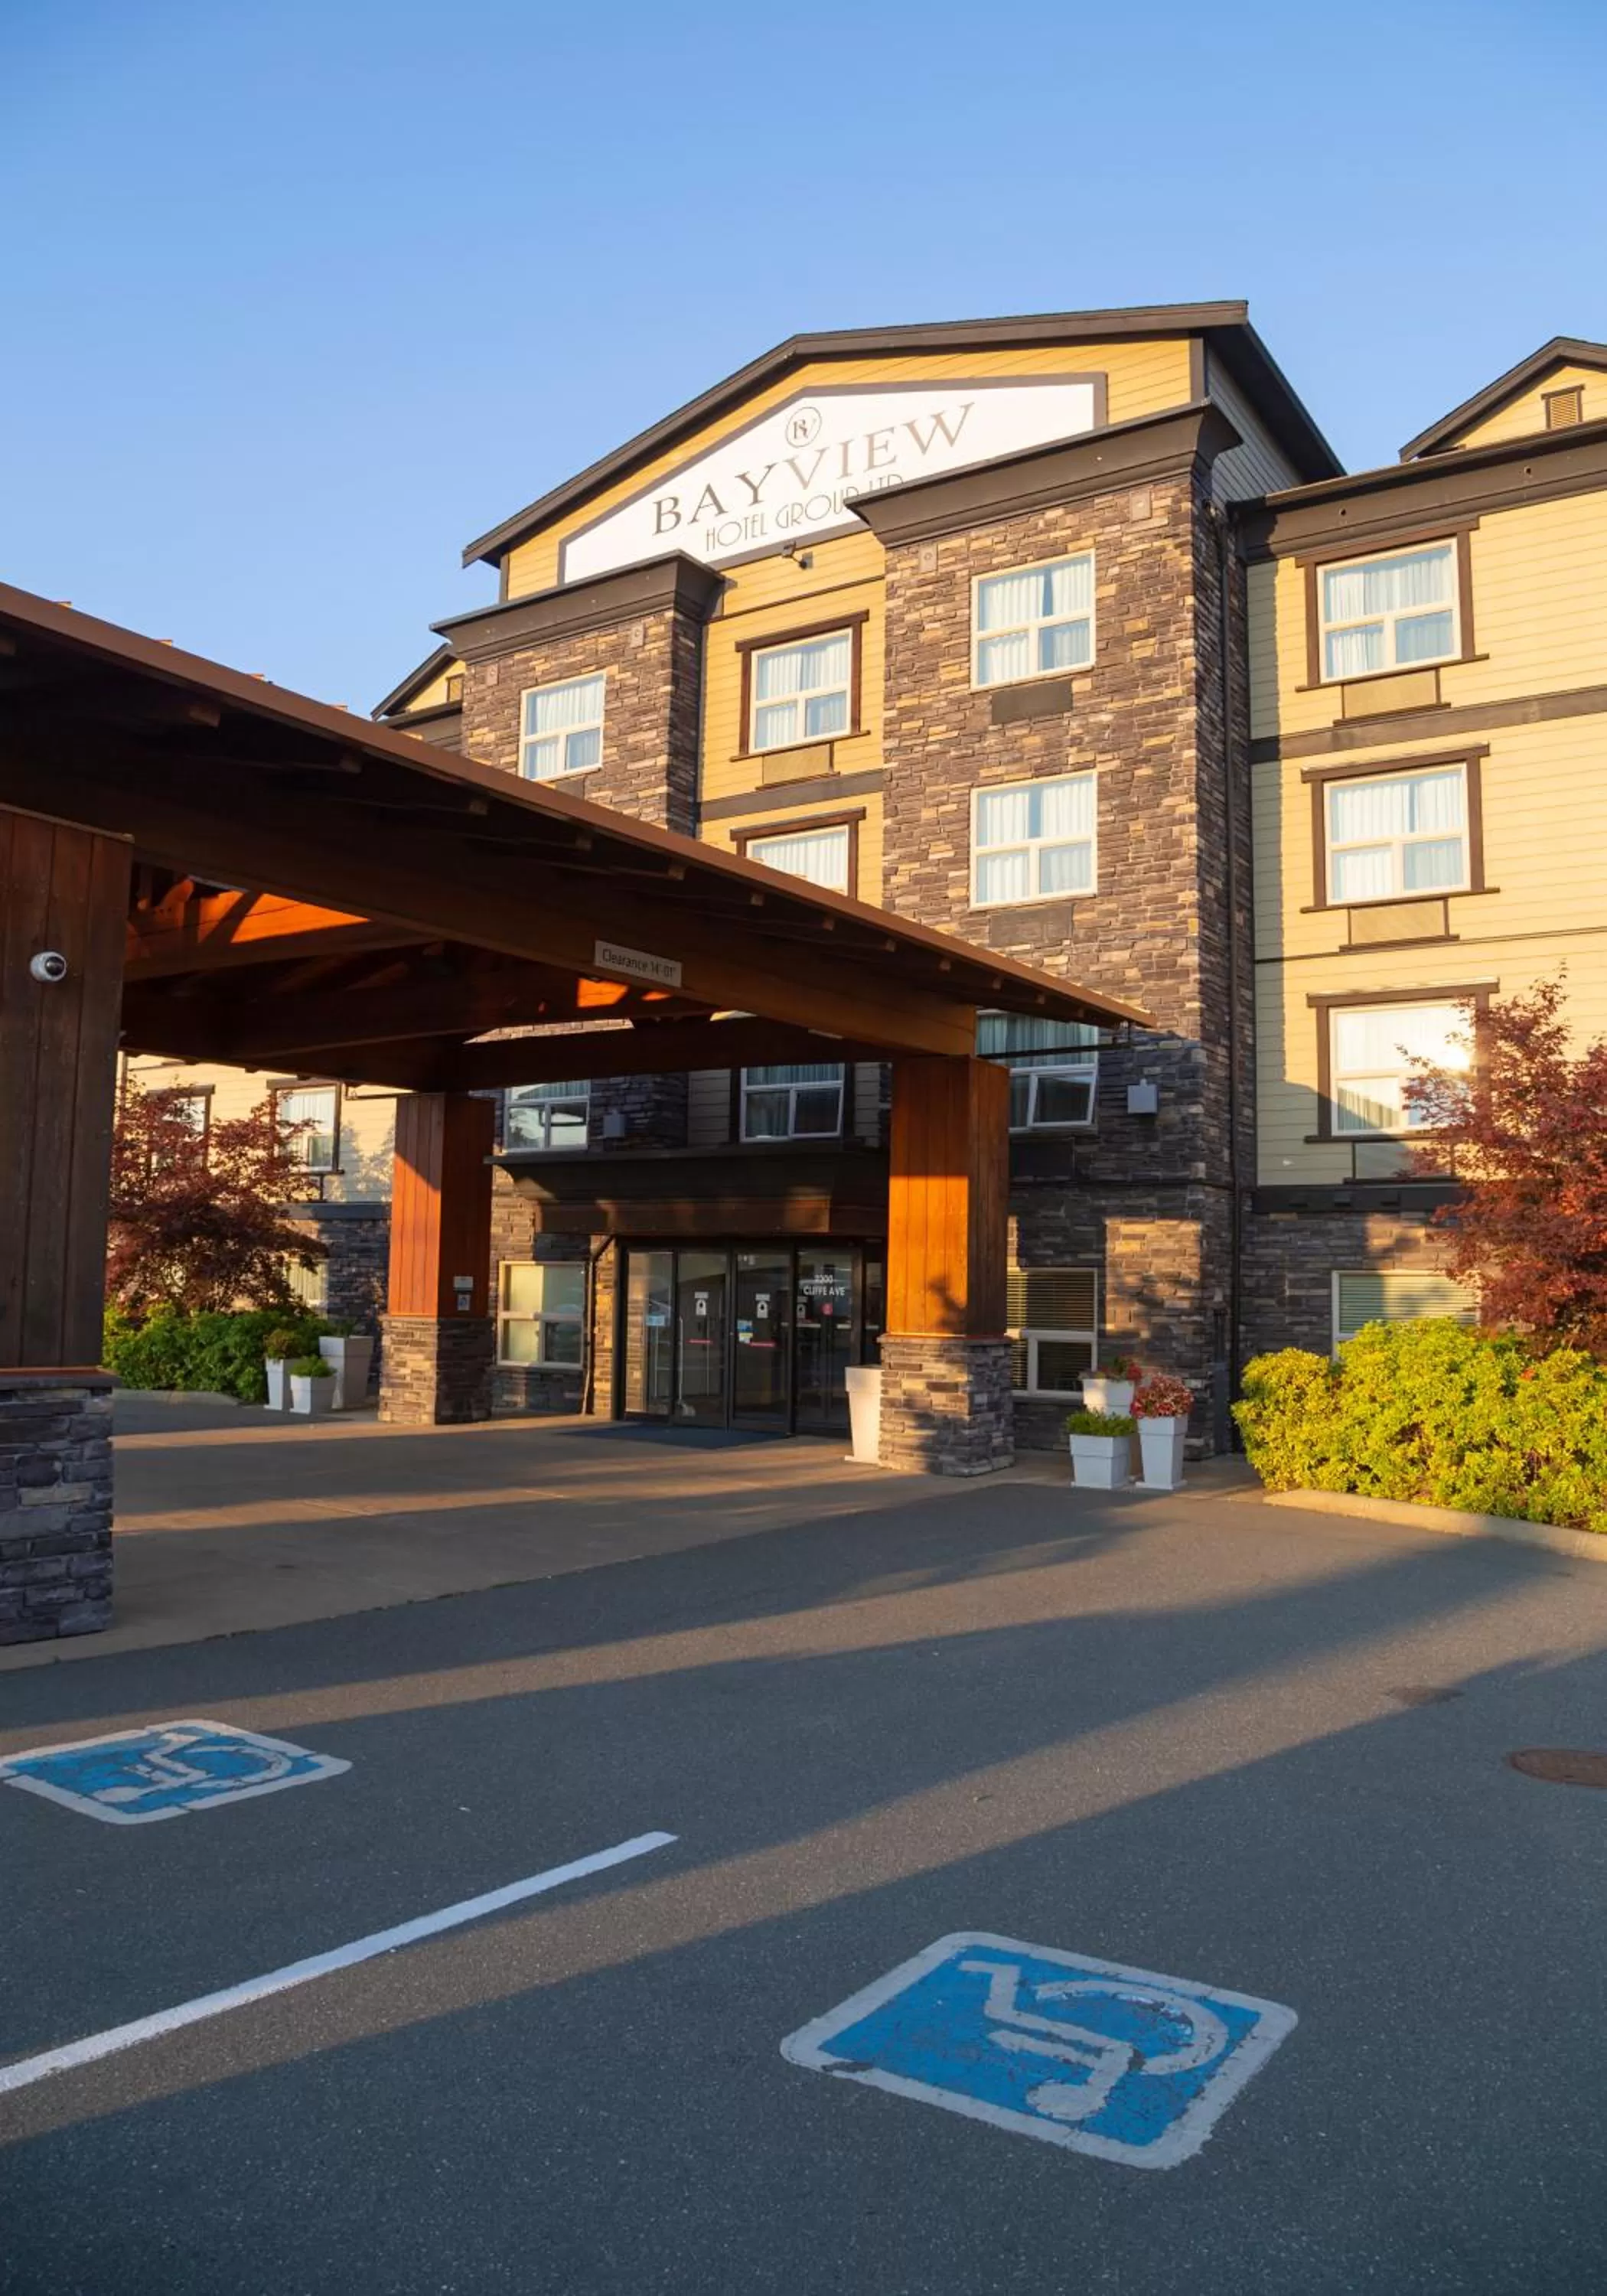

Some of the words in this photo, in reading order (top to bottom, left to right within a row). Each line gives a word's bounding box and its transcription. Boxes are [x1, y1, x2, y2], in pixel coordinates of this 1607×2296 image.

[651, 400, 976, 536] BAYVIEW
[705, 512, 768, 552] HOTEL
[829, 1287, 846, 1296] AVE
